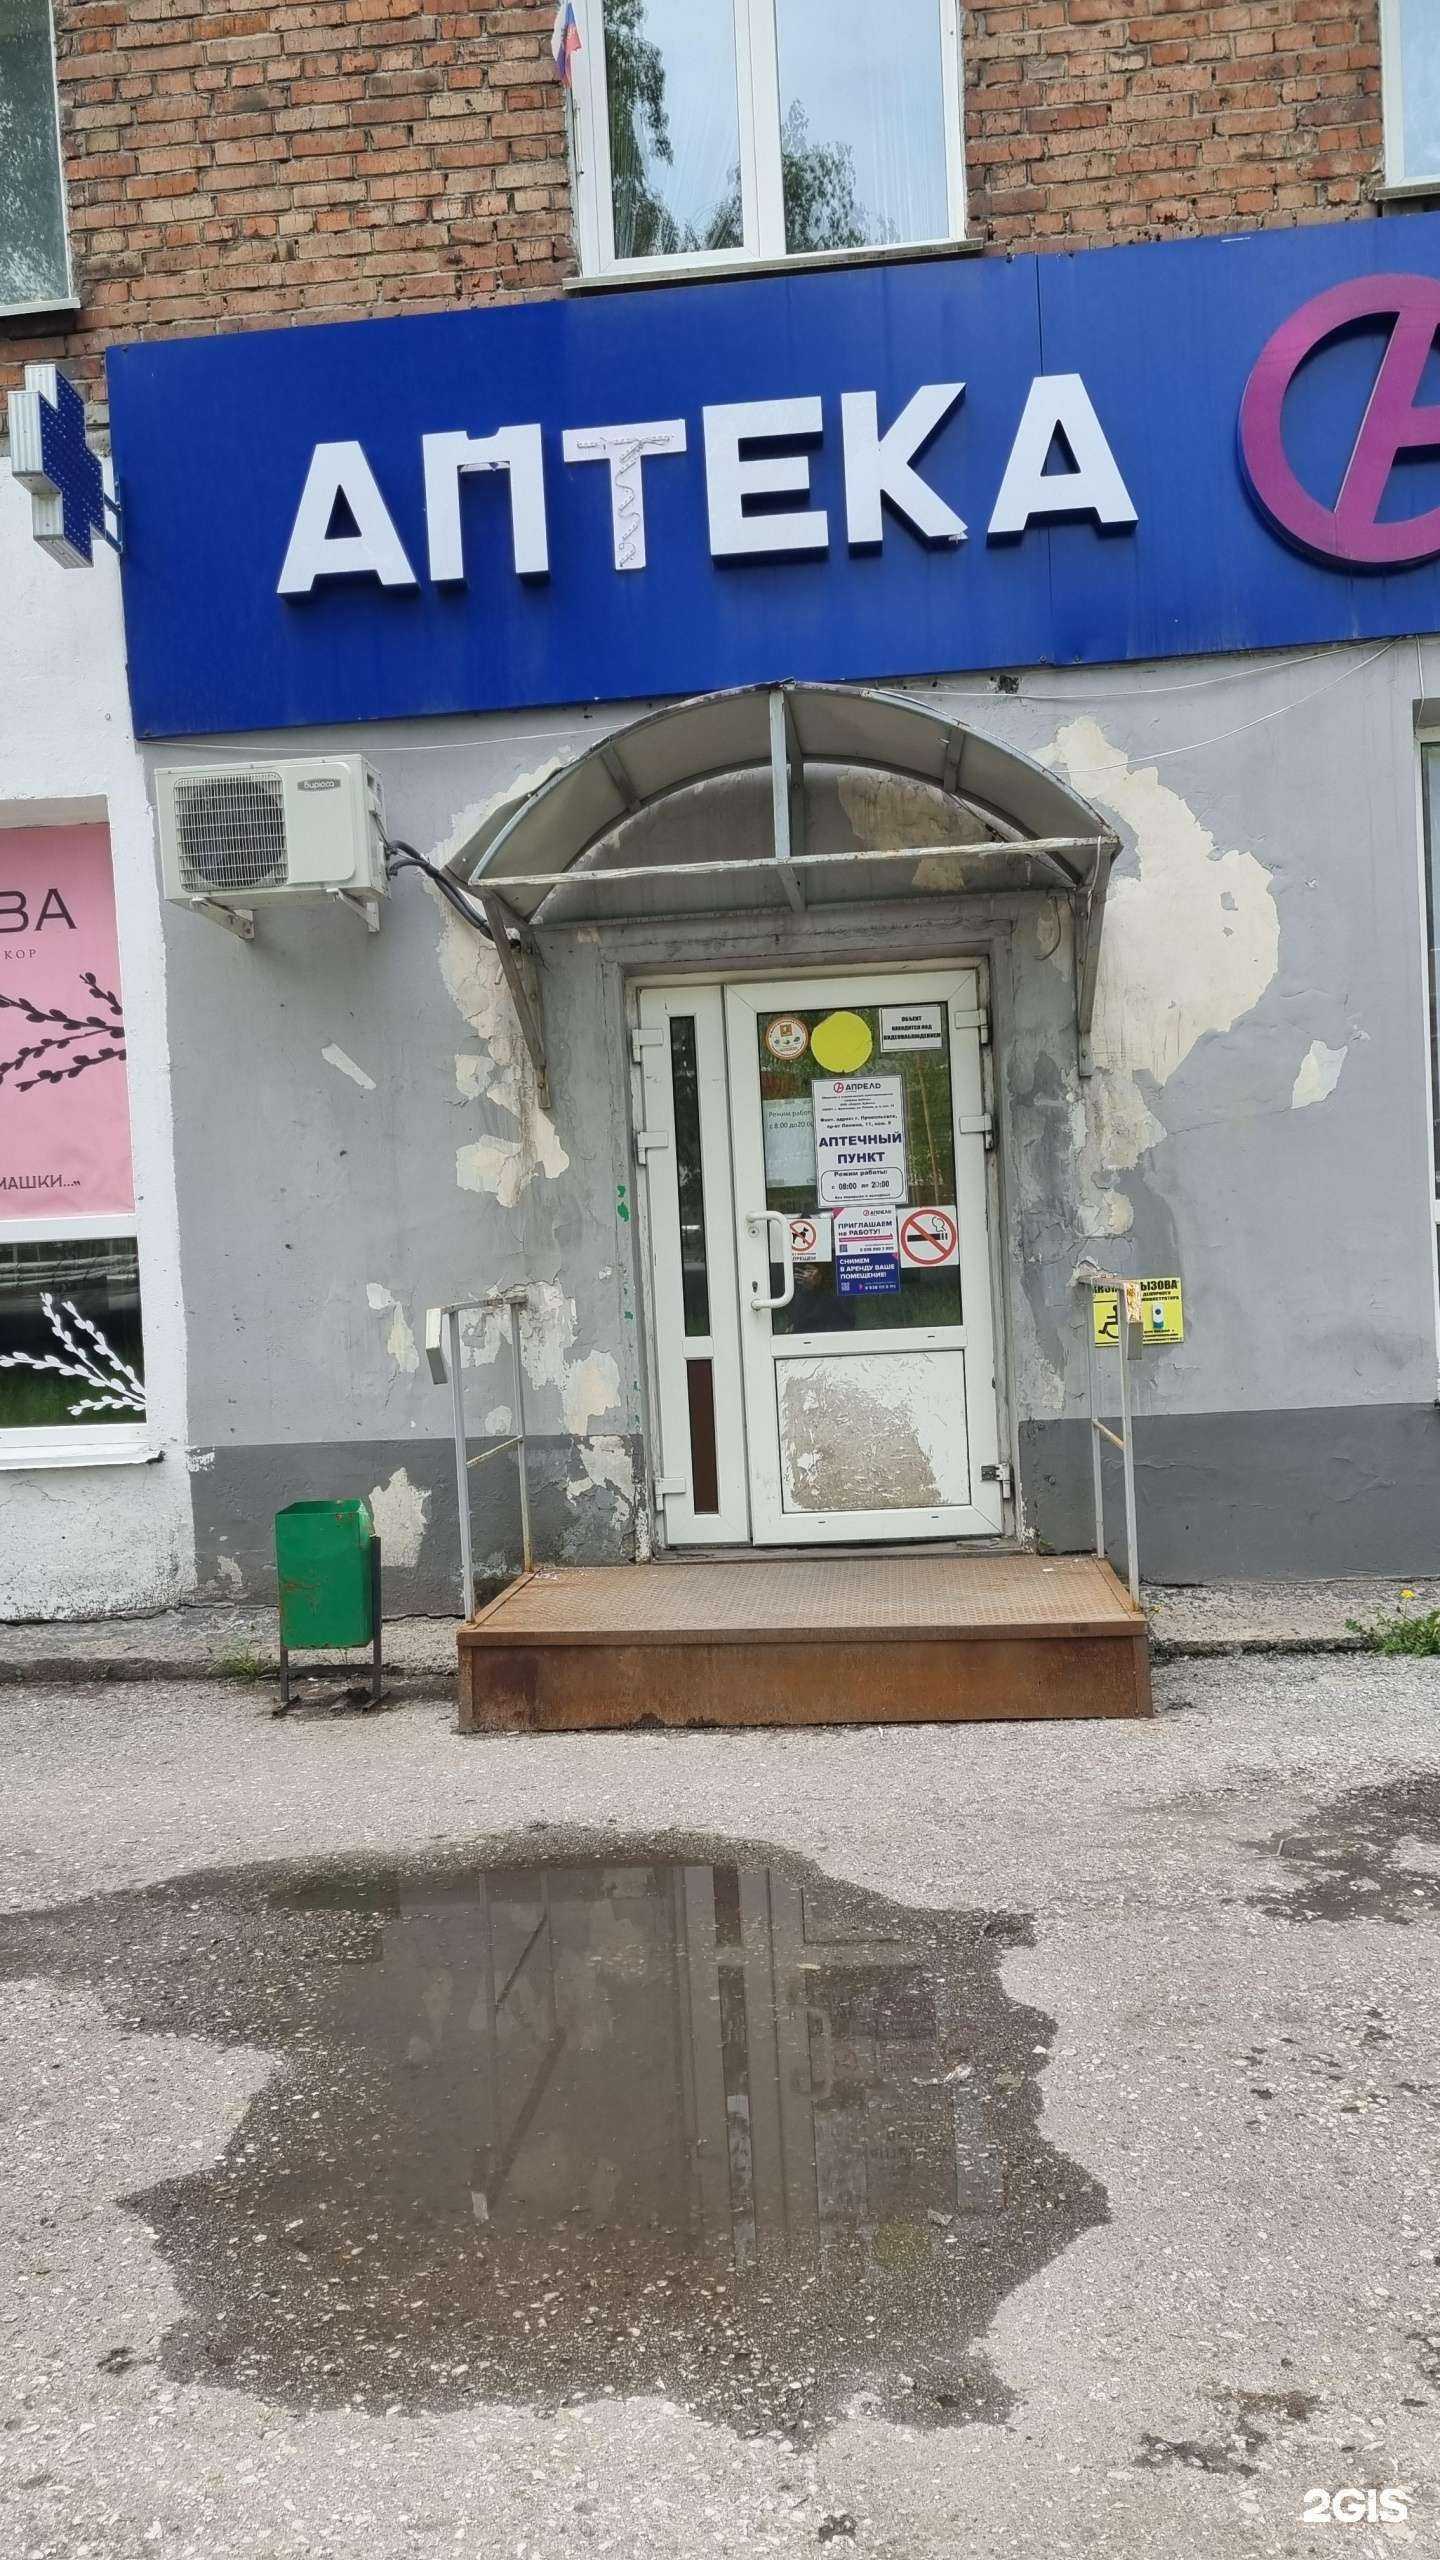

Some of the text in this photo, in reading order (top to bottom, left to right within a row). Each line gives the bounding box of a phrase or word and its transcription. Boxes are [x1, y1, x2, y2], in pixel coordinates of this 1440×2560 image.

[276, 373, 1139, 597] АПТЕКА
[845, 1082, 882, 1091] АПРЕЛЬ
[819, 1131, 902, 1147] АПТЕЧНЫЙ
[837, 1152, 886, 1164] ПУНКТ
[838, 1221, 893, 1230] ПРИГЛАШАЕМ
